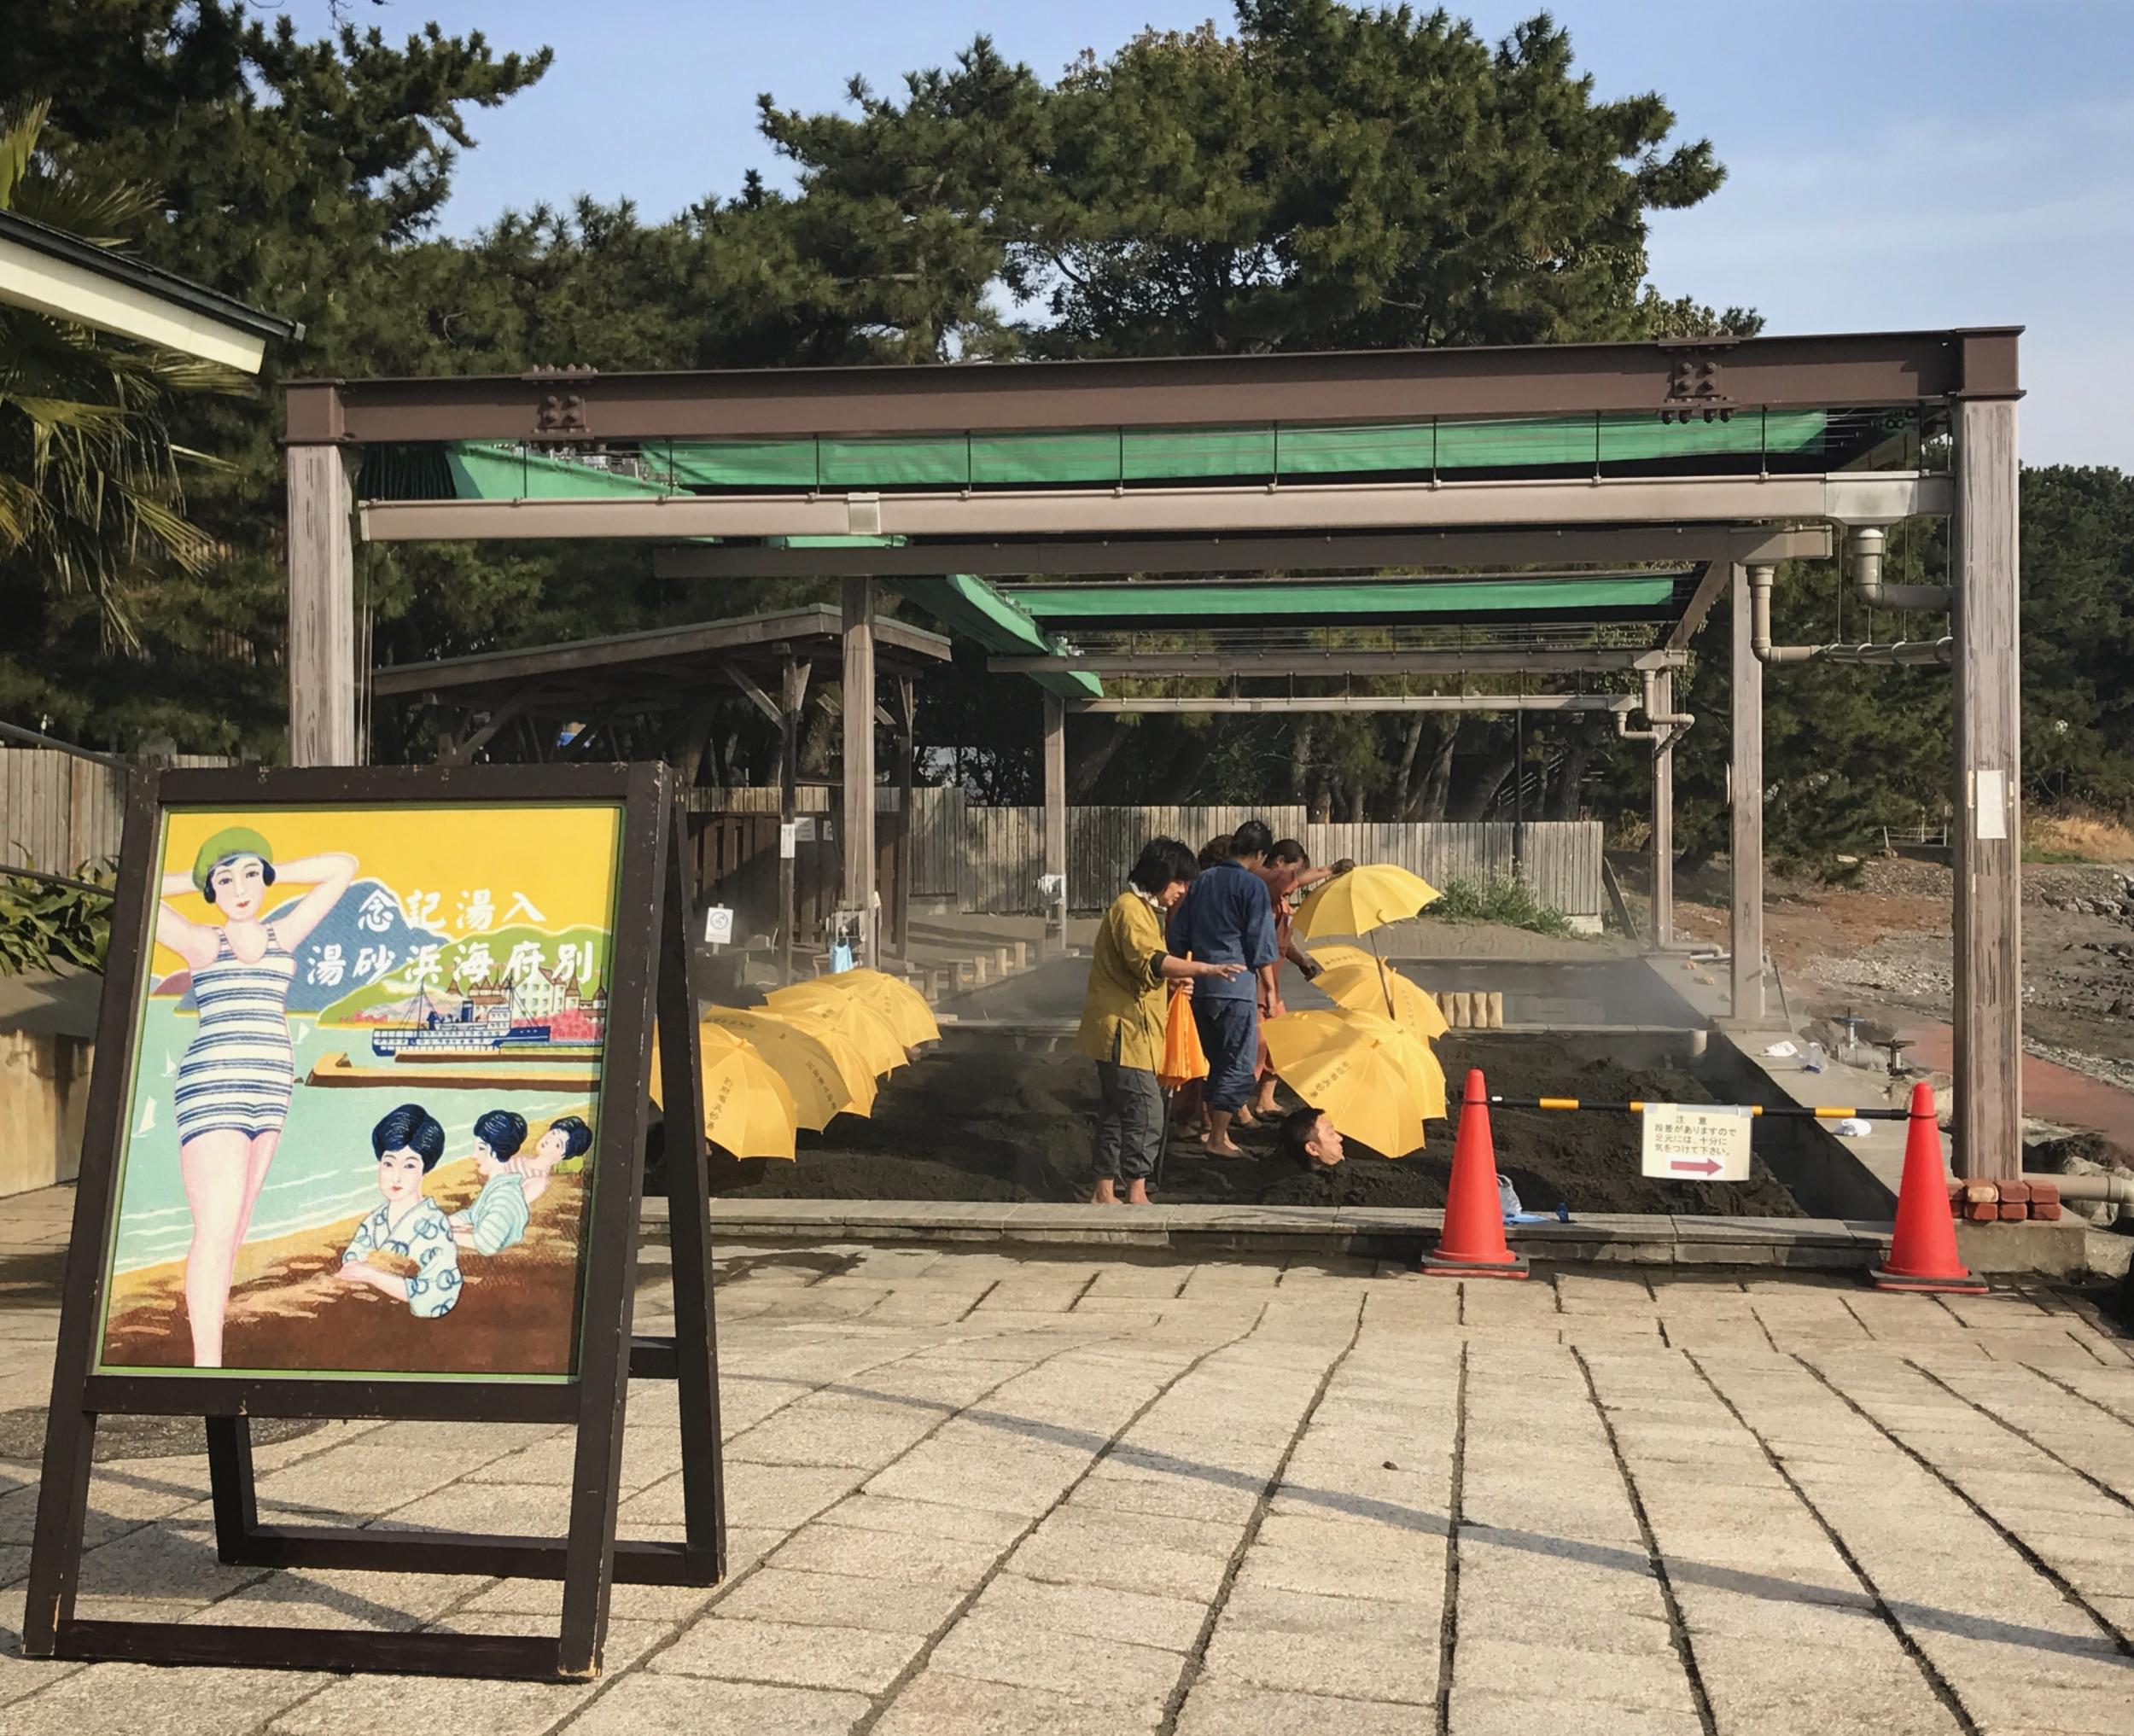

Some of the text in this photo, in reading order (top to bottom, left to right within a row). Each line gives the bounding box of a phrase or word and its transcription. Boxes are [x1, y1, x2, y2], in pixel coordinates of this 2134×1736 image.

[1654, 1123, 1737, 1137] 段差がありますので
